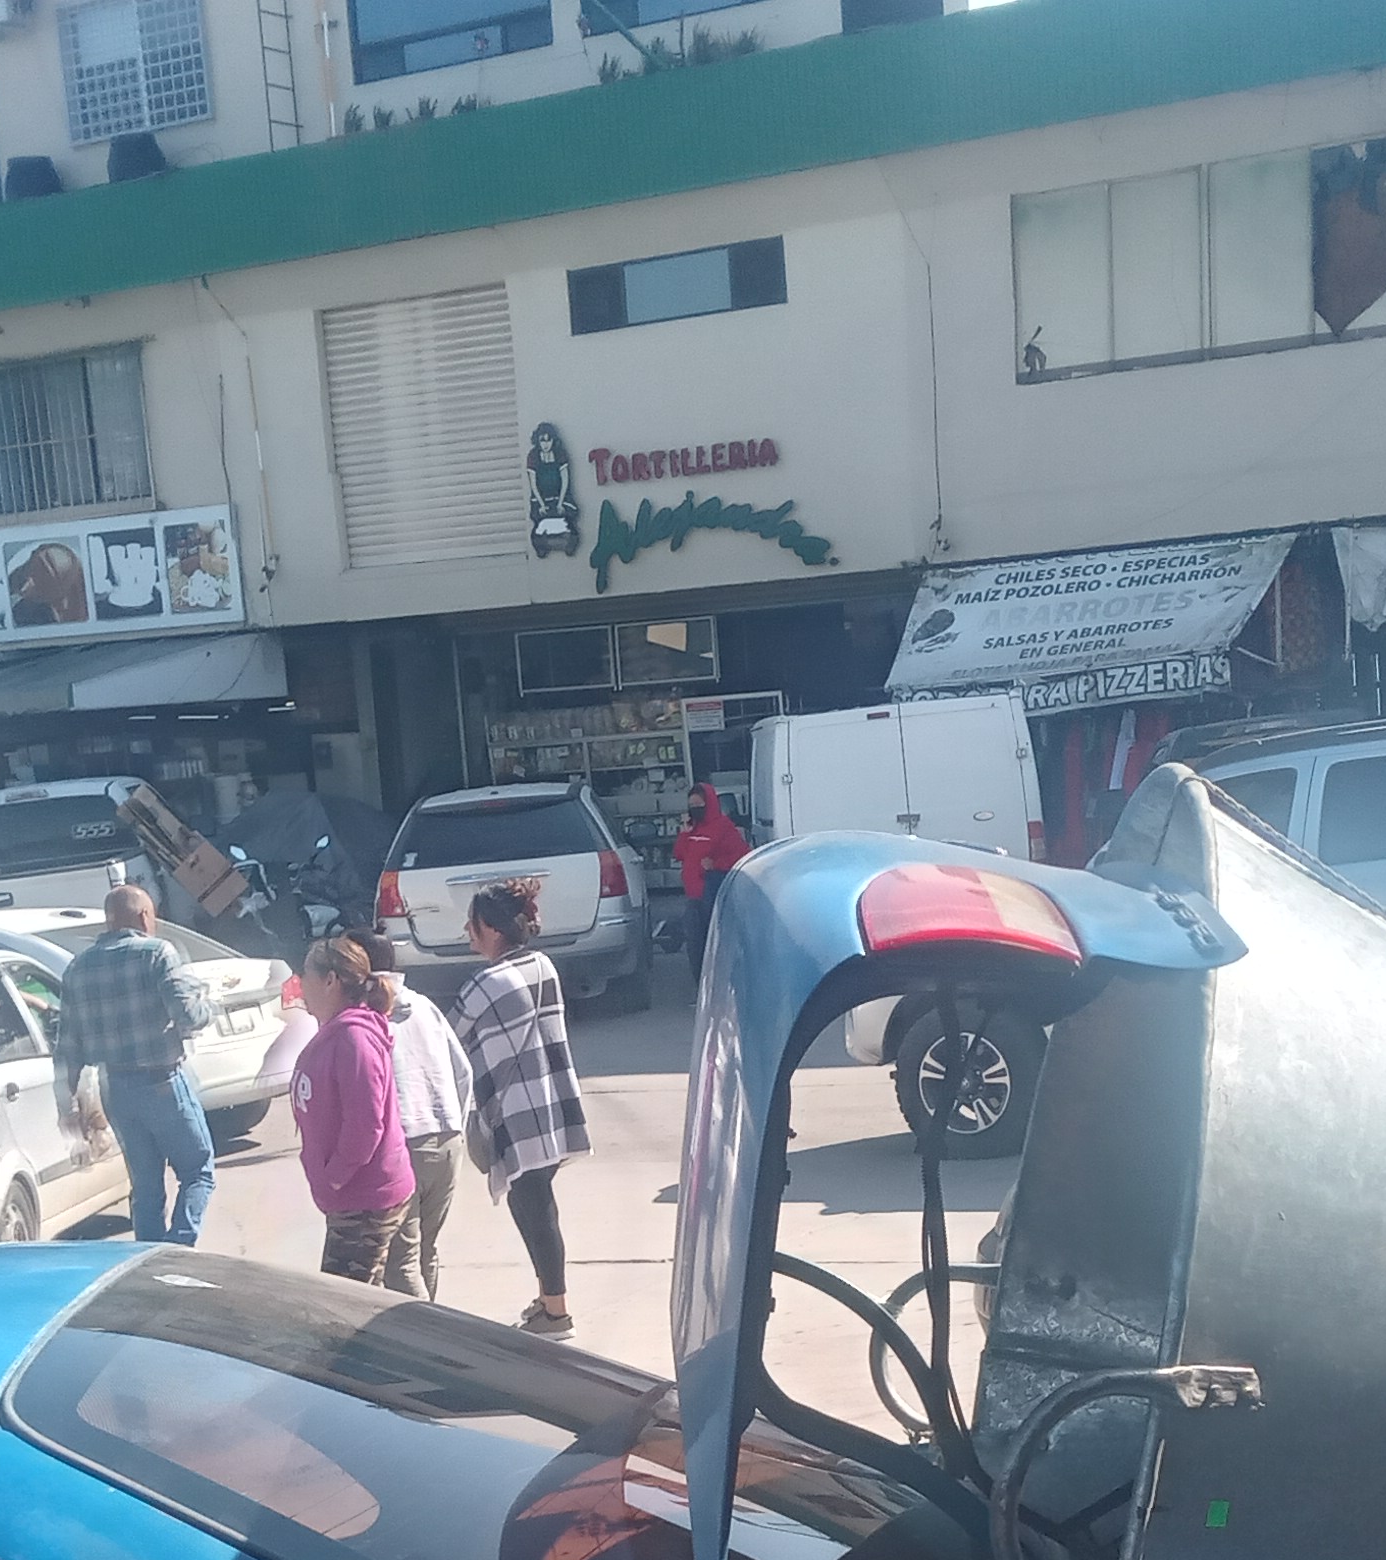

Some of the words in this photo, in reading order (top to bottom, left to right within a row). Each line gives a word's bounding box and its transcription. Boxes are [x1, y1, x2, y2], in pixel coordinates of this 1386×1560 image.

[588, 437, 779, 486] TORTILLERIA
[954, 584, 1001, 605] MAÍZ
[1003, 579, 1101, 601] POZOLERO
[1116, 564, 1244, 589] CHICHARRÓN
[994, 567, 1056, 586] CHILES
[1059, 562, 1107, 580] SECO
[1121, 552, 1211, 574] ESPECIAS
[981, 589, 1197, 631] ABARROTES
[982, 630, 1048, 650] SALSAS
[1051, 628, 1065, 642] Y
[1065, 617, 1174, 642] ABARROTES
[1018, 645, 1046, 660] EN
[1047, 637, 1126, 658] GENERAL
